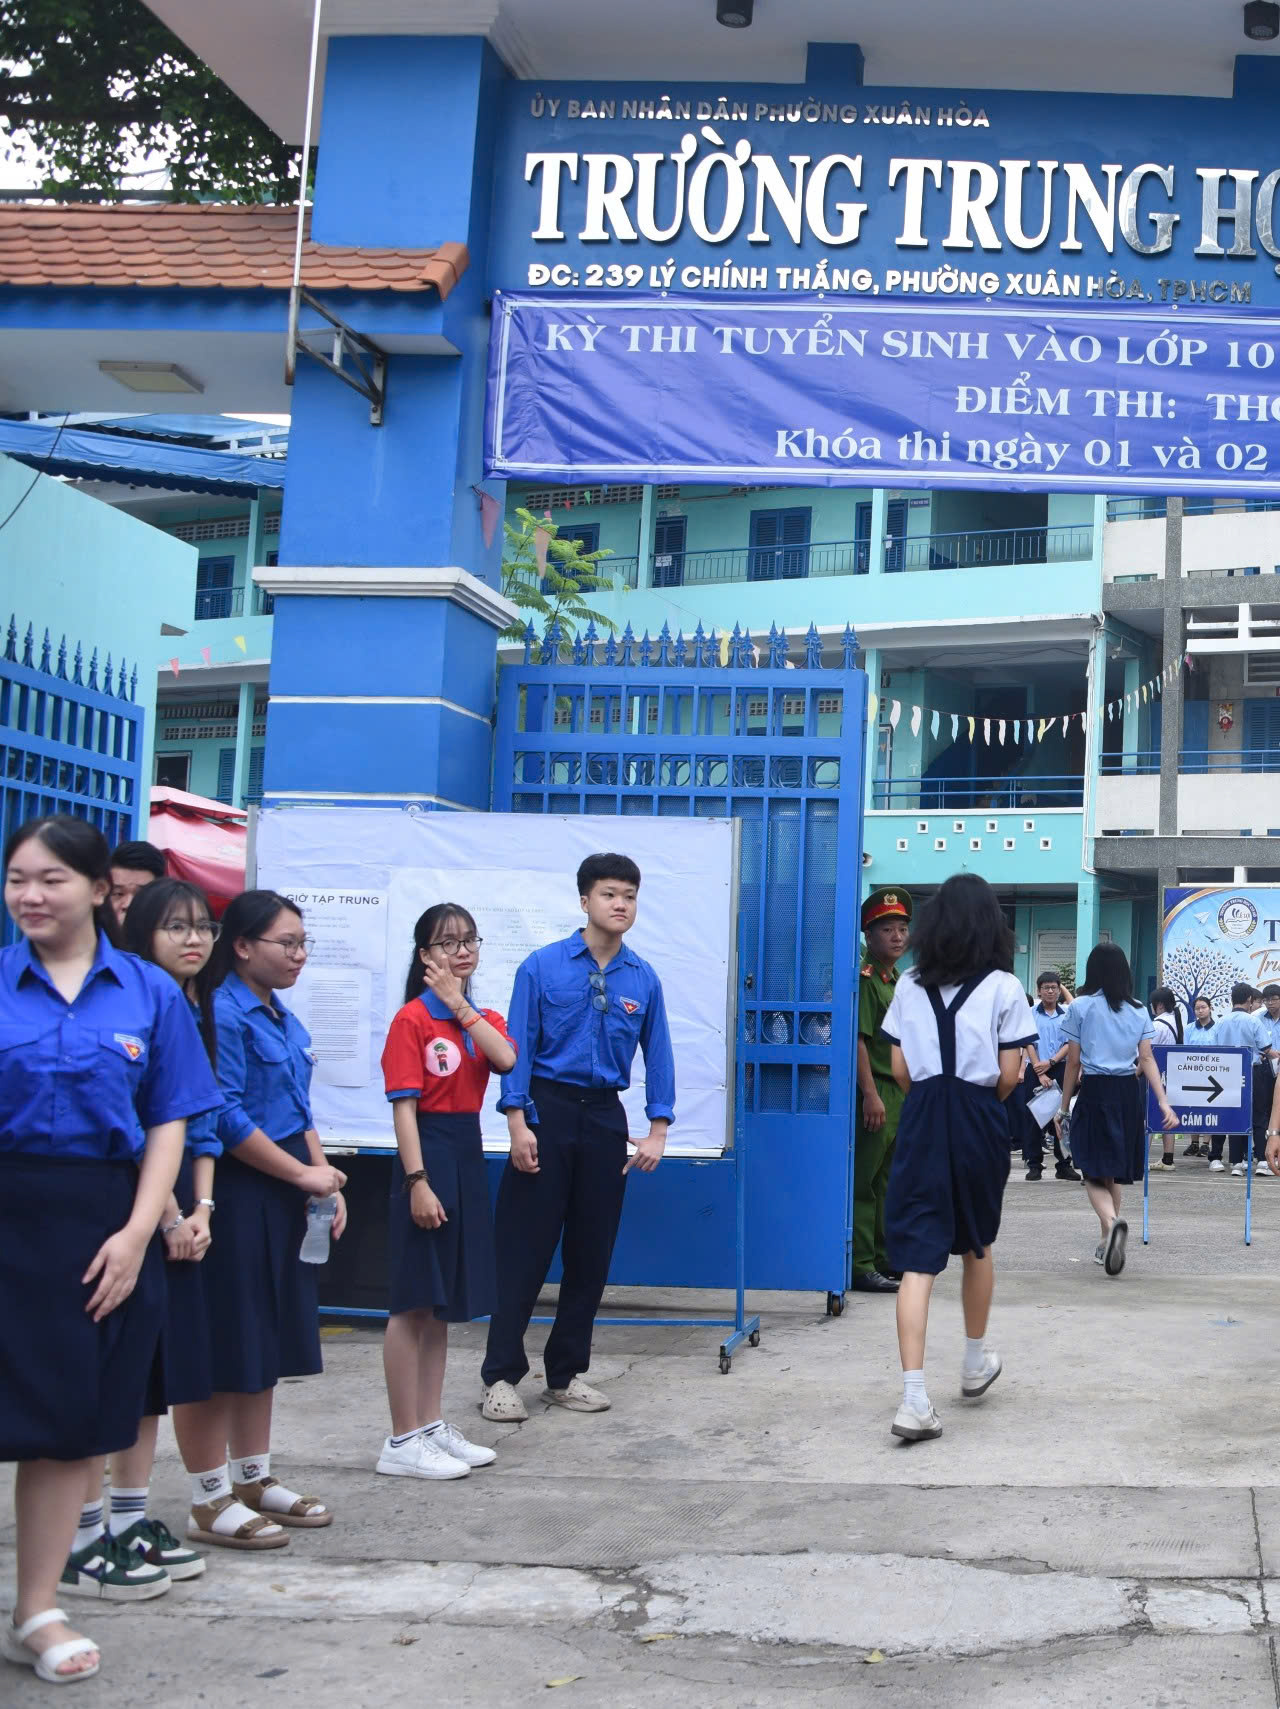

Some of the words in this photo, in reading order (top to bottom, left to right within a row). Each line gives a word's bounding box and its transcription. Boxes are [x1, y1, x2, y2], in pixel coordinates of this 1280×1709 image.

[530, 92, 561, 118] ỦY
[567, 99, 616, 119] BAN
[621, 95, 691, 120] NHÂN
[696, 96, 749, 121] DÂN
[754, 96, 858, 124] PHƯỜNG
[863, 101, 931, 126] XUÂN
[937, 100, 990, 128] HÒA
[524, 125, 868, 245] TRƯỜNG
[888, 158, 1181, 254] TRUNG
[527, 263, 580, 286] ĐC:
[585, 263, 644, 287] 239
[649, 258, 677, 288] LÝ
[681, 258, 768, 289] CHÍNH
[775, 258, 880, 295] THẮNG,
[885, 264, 1000, 294] PHƯỜNG
[1005, 269, 1081, 297] XUÂN
[1087, 269, 1153, 303] HÒA,
[1157, 279, 1252, 304] TPHCM
[545, 314, 607, 352] KỲ
[619, 324, 698, 353] THI
[712, 312, 870, 358] TUYỂN
[881, 329, 990, 360] SINH
[1003, 324, 1103, 363] VÀO
[1115, 328, 1209, 367] LỚP
[1226, 341, 1276, 369] 10
[955, 371, 1071, 416] ĐIỂM
[1085, 389, 1177, 419] THI:
[775, 427, 882, 460] Khóa
[897, 430, 952, 462] thi
[966, 431, 1072, 472] ngày
[1083, 439, 1134, 468] 01
[1151, 436, 1202, 470] và
[1215, 442, 1268, 472] 02
[339, 896, 380, 905] TRUNG
[1181, 1112, 1202, 1126] CÁM
[1205, 1113, 1218, 1127] ƠN
